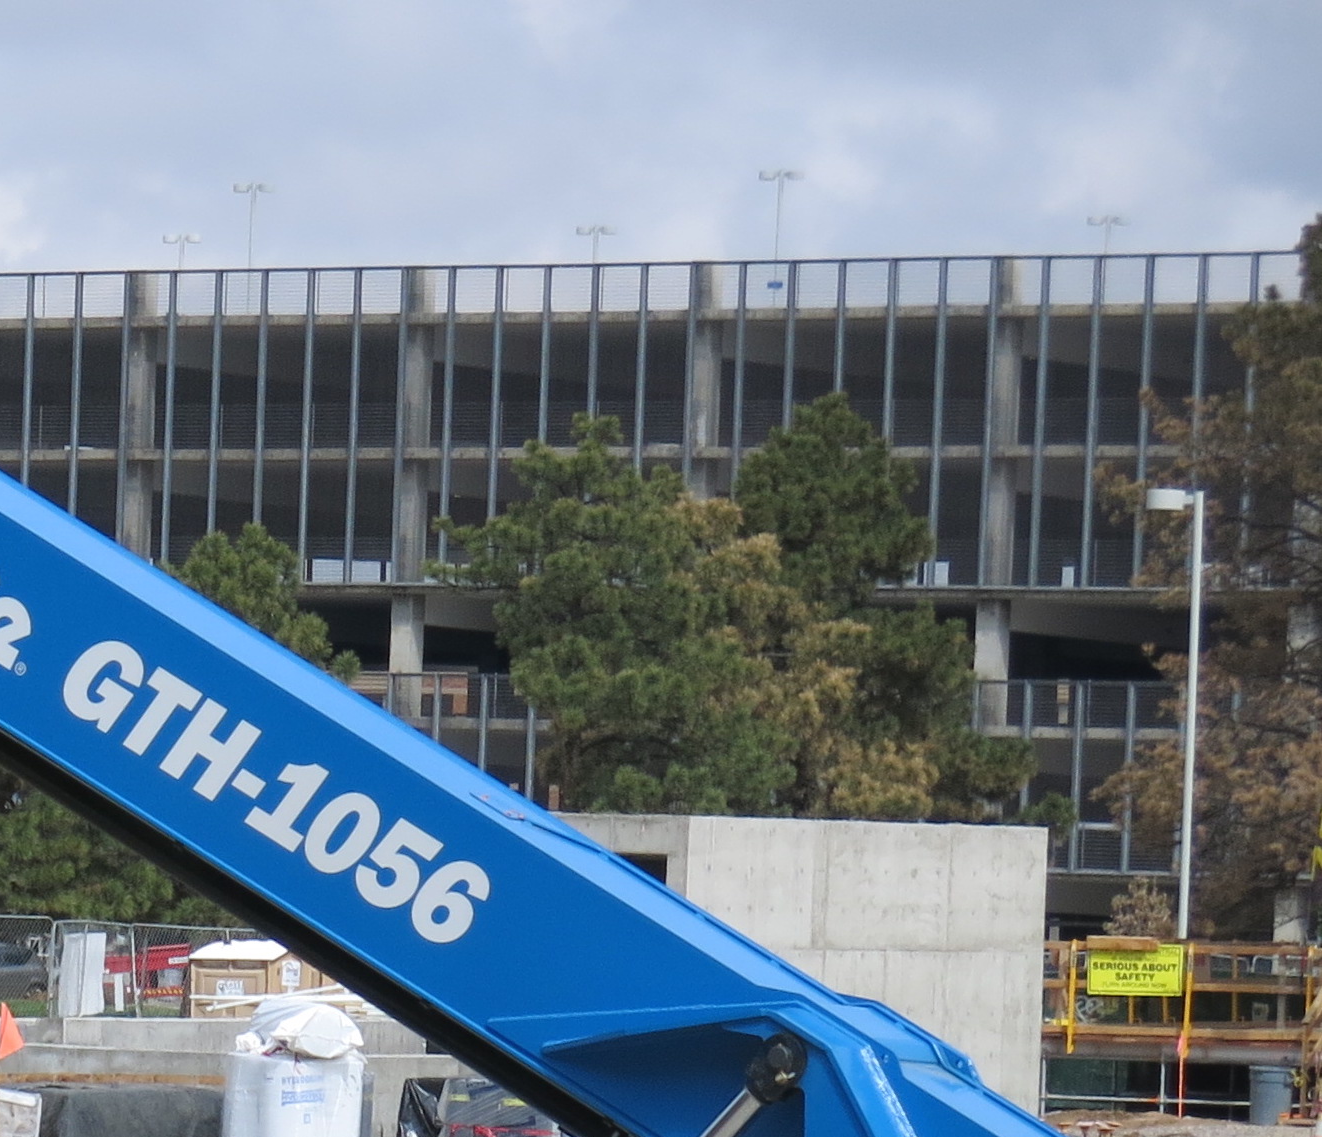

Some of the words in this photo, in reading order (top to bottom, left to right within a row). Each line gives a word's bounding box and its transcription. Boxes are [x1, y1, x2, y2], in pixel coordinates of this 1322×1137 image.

[63, 640, 490, 943] GTH-1056
[1093, 961, 1139, 971] SERIOUS
[1141, 963, 1177, 973] ABOUT
[1115, 972, 1155, 981] SAFETY
